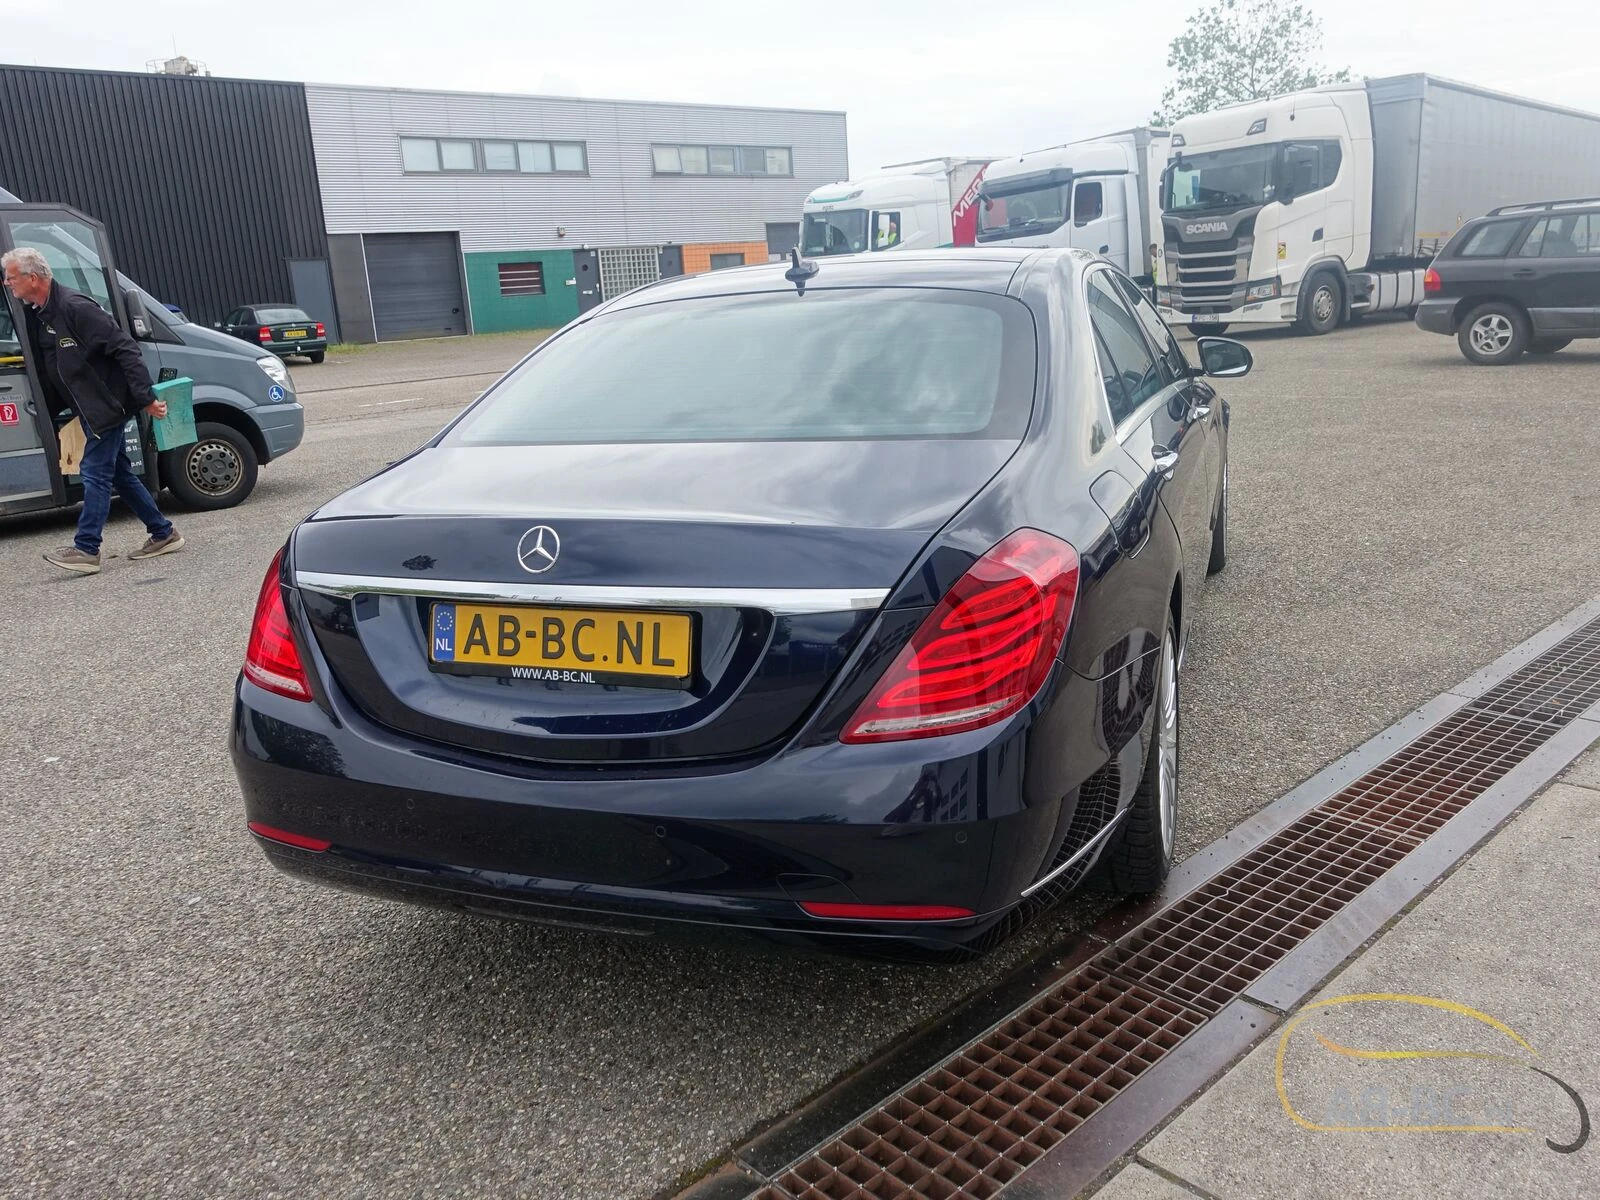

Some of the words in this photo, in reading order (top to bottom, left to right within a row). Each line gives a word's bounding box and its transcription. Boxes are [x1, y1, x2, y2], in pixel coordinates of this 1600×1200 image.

[1186, 221, 1228, 234] SCANIA
[435, 638, 453, 651] NL
[463, 613, 675, 667] AB-BC.NL
[511, 666, 596, 683] WWW.AB-BC.NL
